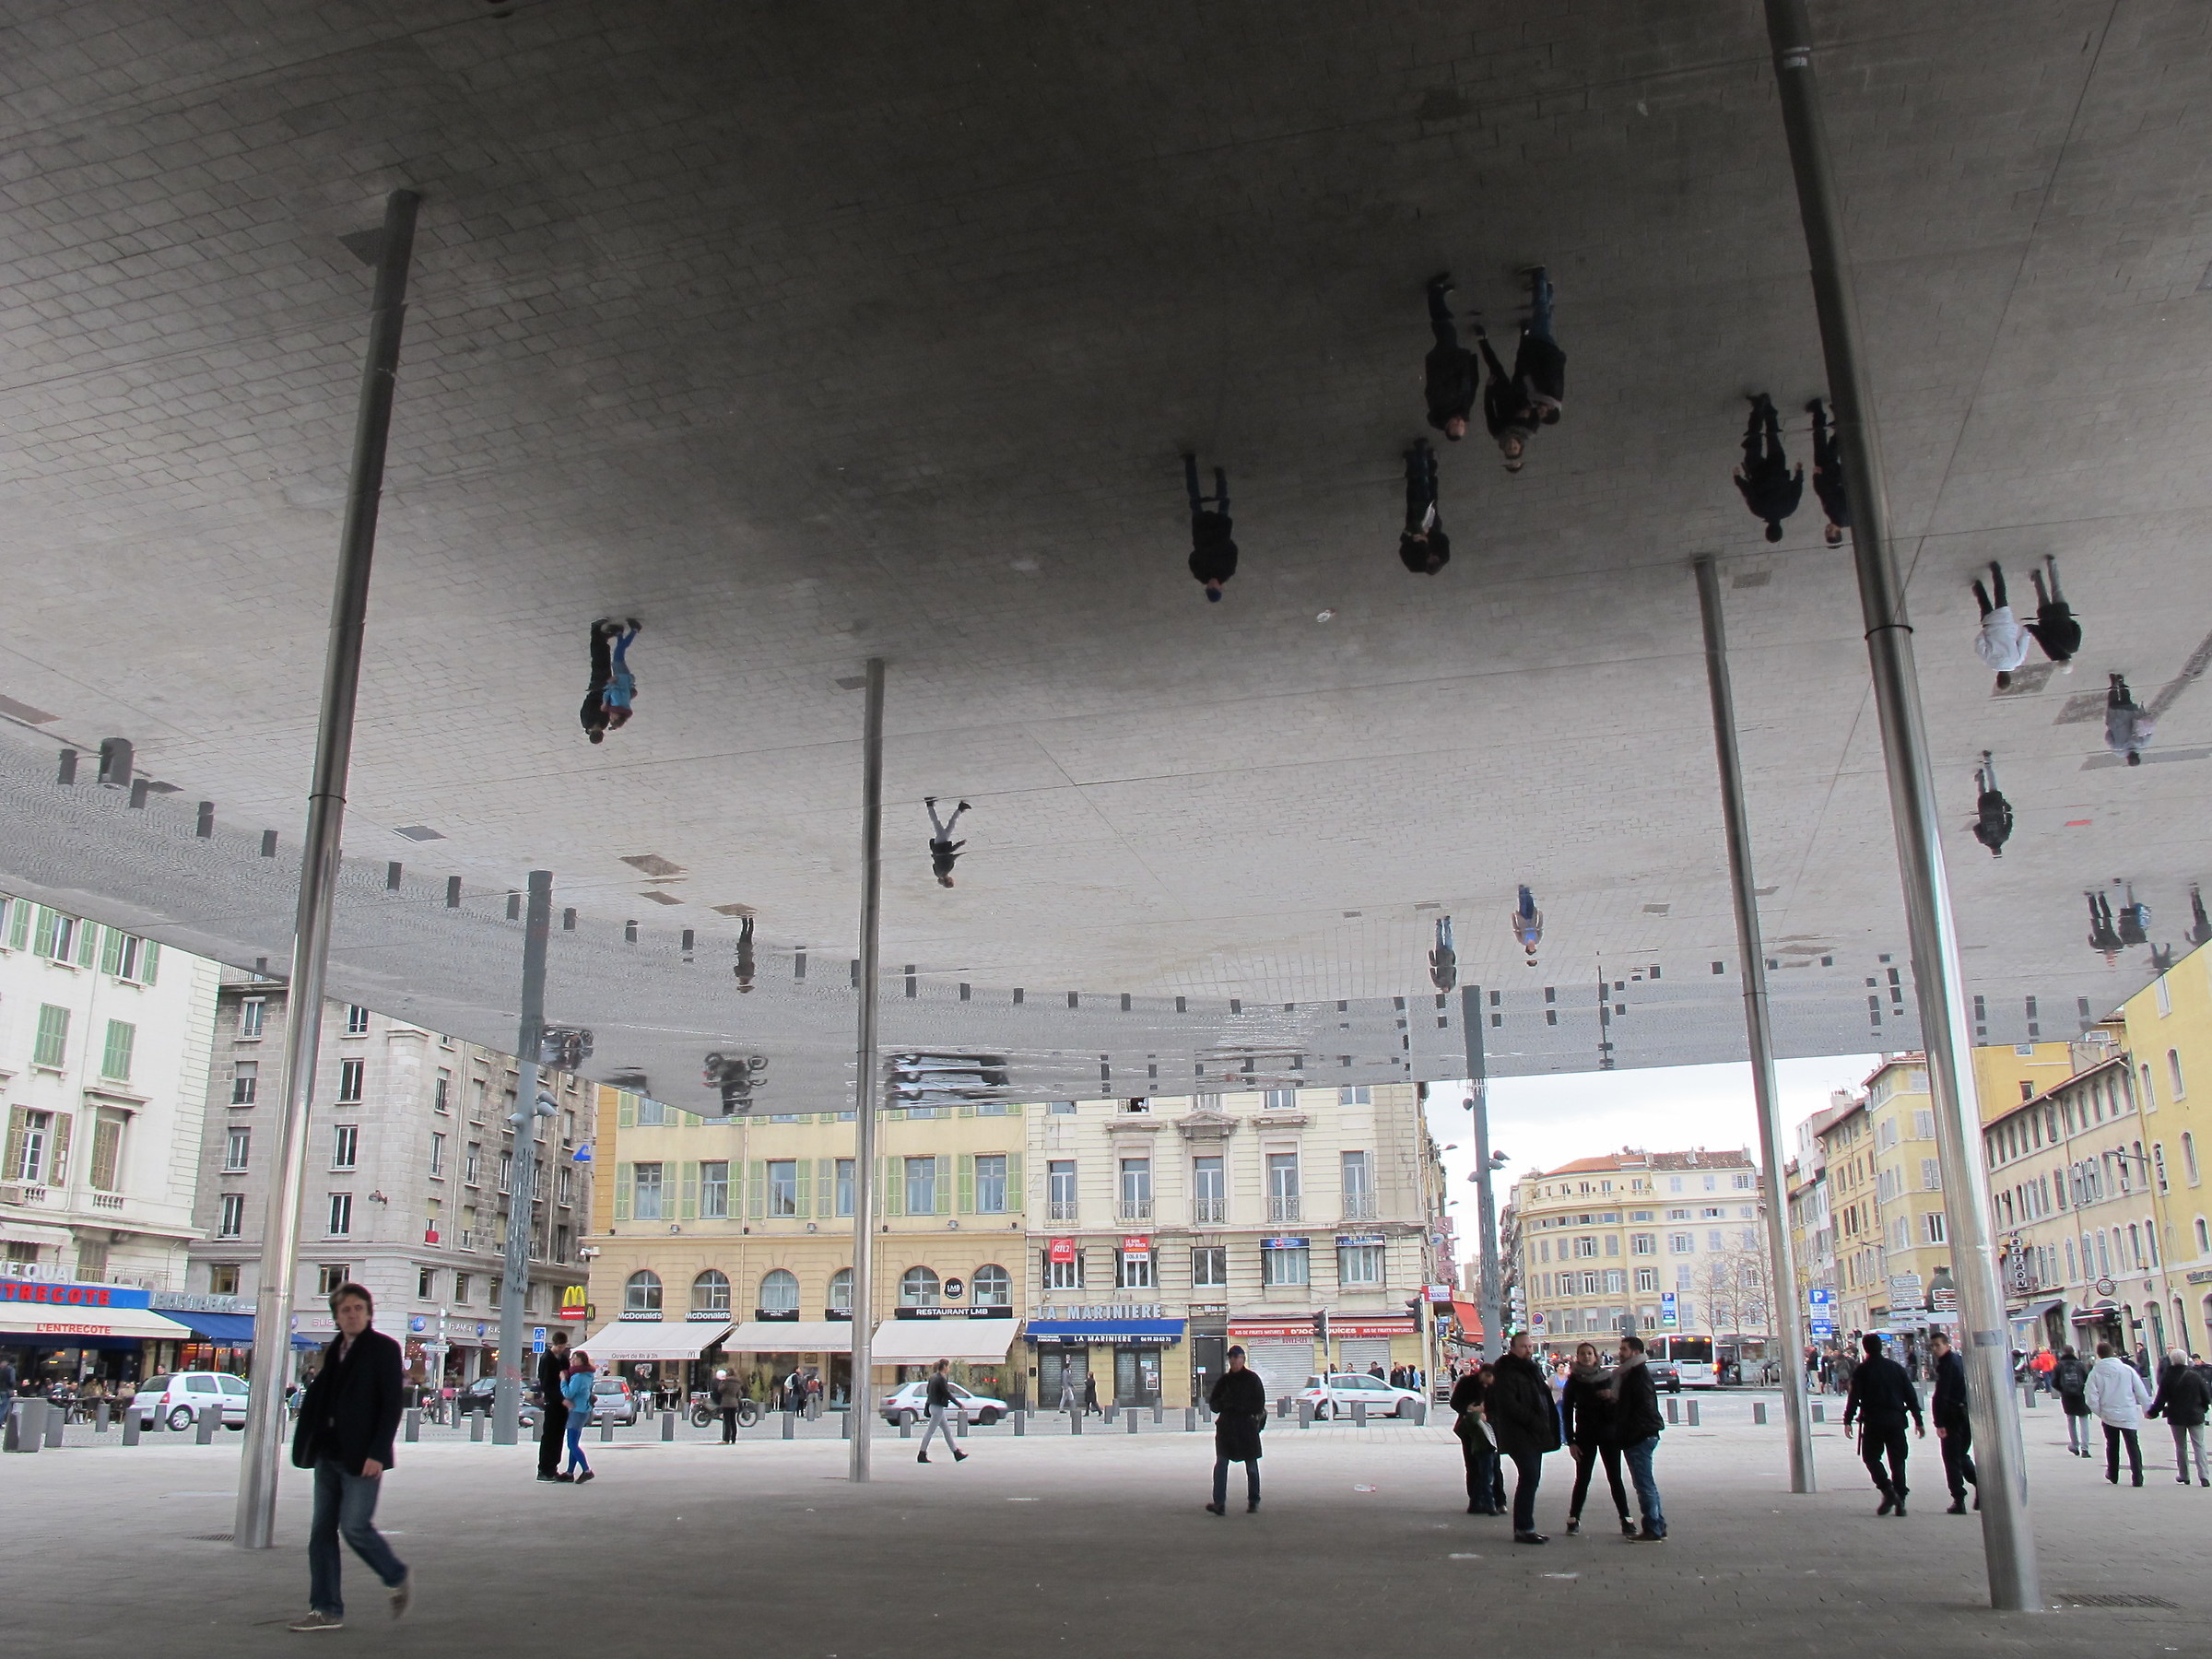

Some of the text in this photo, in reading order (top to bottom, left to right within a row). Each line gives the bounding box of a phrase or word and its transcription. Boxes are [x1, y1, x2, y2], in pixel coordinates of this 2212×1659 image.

[1053, 1244, 1070, 1253] RTL2
[24, 1263, 76, 1282] QUAI
[0, 1283, 112, 1305] TRECOTE
[1812, 1290, 1823, 1302] P
[618, 1312, 663, 1320] McDonald's
[685, 1312, 731, 1320] McDonald's
[1037, 1303, 1161, 1320] LA MARINIERE
[36, 1324, 112, 1335] L'ENTRECOTE
